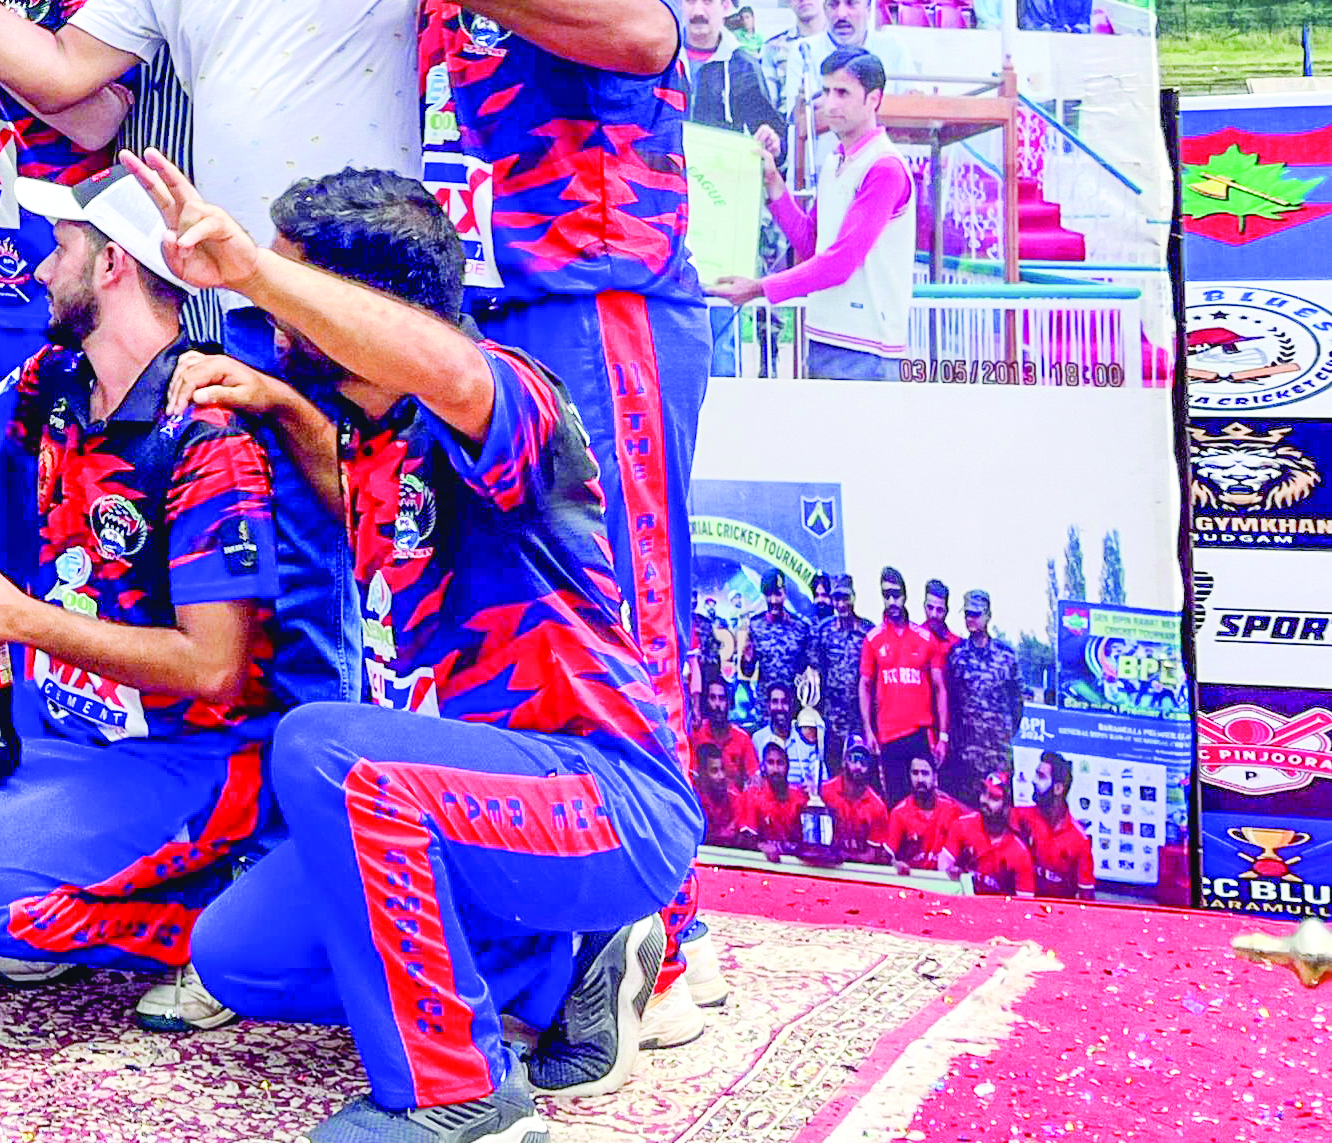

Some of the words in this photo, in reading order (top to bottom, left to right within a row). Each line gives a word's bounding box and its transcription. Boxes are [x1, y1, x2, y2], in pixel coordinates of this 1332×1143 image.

[1203, 289, 1332, 335] BLUES
[899, 358, 1037, 386] 03/05/2013
[1053, 362, 1124, 387] 18:00
[1217, 378, 1317, 407] CRICKET
[621, 412, 650, 484] THE
[635, 514, 663, 607] REAL
[716, 523, 761, 550] CRICKET
[762, 537, 815, 590] TOURNAM
[1215, 613, 1332, 642] SPOR
[1117, 655, 1178, 686] BPL
[43, 681, 126, 726] CEMENT
[1201, 897, 1332, 917] ARAMULL
[1251, 880, 1332, 906] BLU
